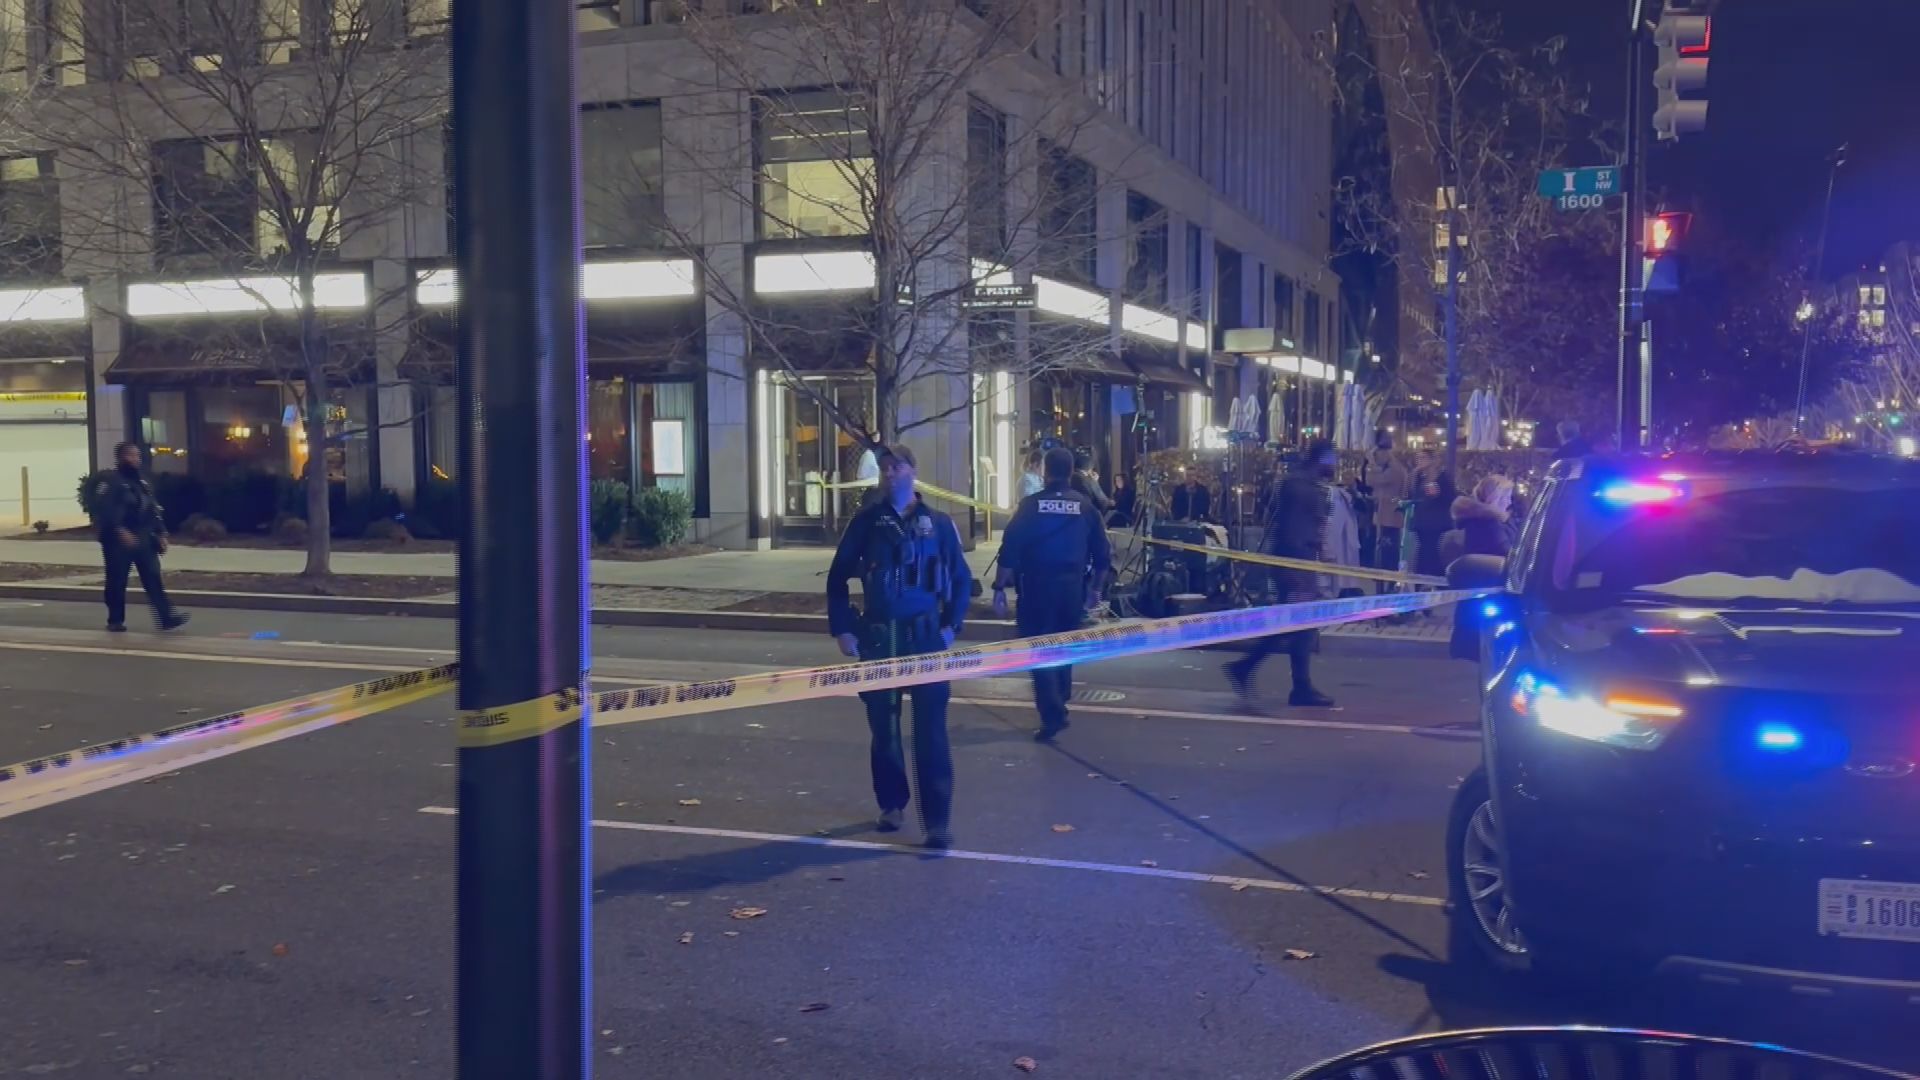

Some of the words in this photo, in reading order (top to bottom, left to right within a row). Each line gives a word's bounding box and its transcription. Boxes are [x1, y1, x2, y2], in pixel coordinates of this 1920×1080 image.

[1563, 172, 1576, 192] I
[1597, 171, 1611, 181] ST
[1595, 181, 1612, 189] NW
[1560, 194, 1603, 208] 1600
[1039, 501, 1080, 513] POLICE
[597, 690, 629, 712] DO
[632, 686, 670, 708] NOT
[1864, 897, 1920, 927] 1606
